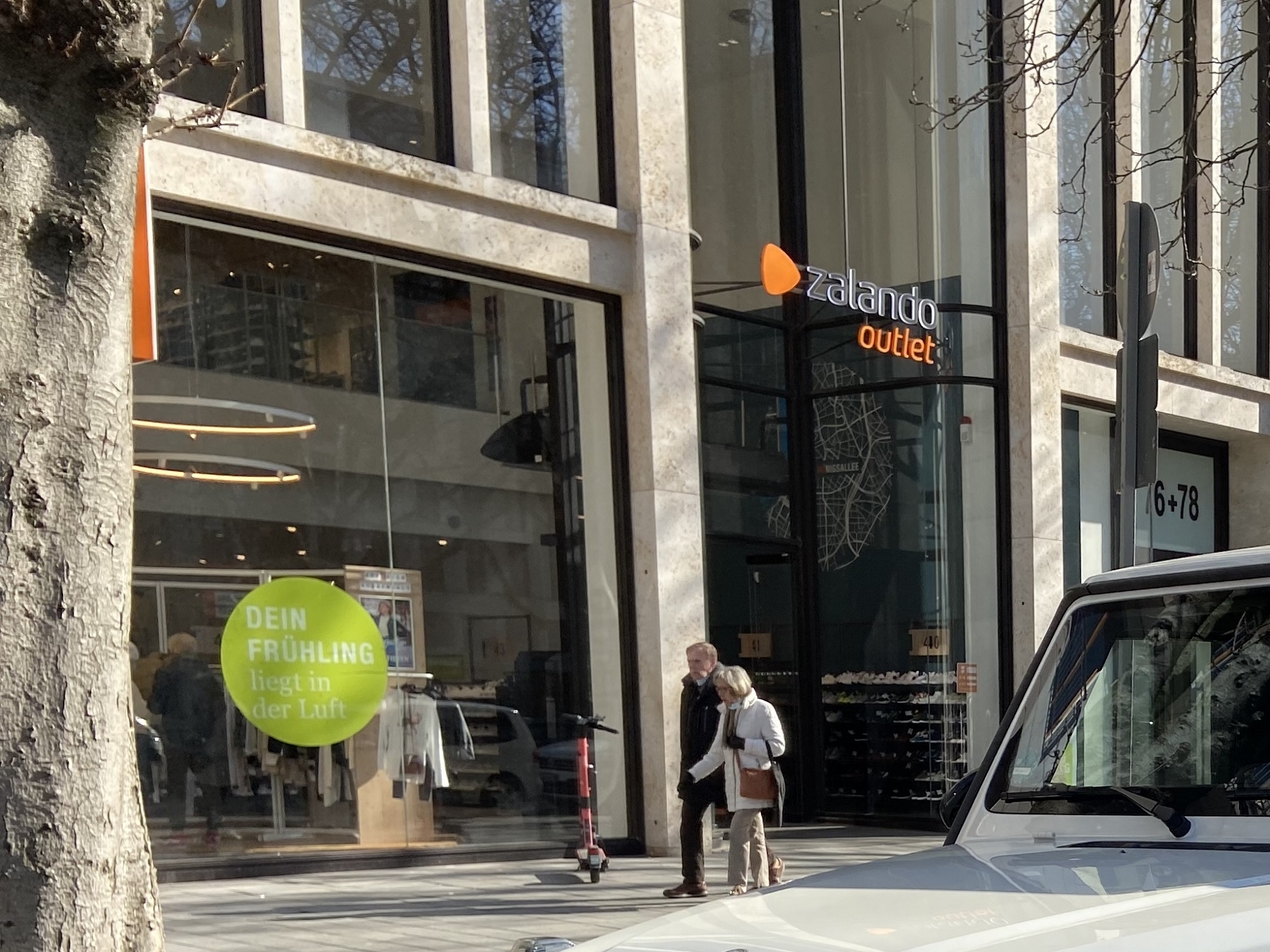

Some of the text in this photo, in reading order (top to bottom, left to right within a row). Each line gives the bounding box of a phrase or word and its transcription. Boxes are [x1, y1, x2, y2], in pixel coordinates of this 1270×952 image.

[806, 266, 938, 330] zalando
[858, 325, 936, 365] outlet
[246, 605, 307, 631] DEIN
[247, 635, 375, 665] FRÜHLING
[249, 669, 331, 696] liegt in
[252, 698, 347, 720] der Luft
